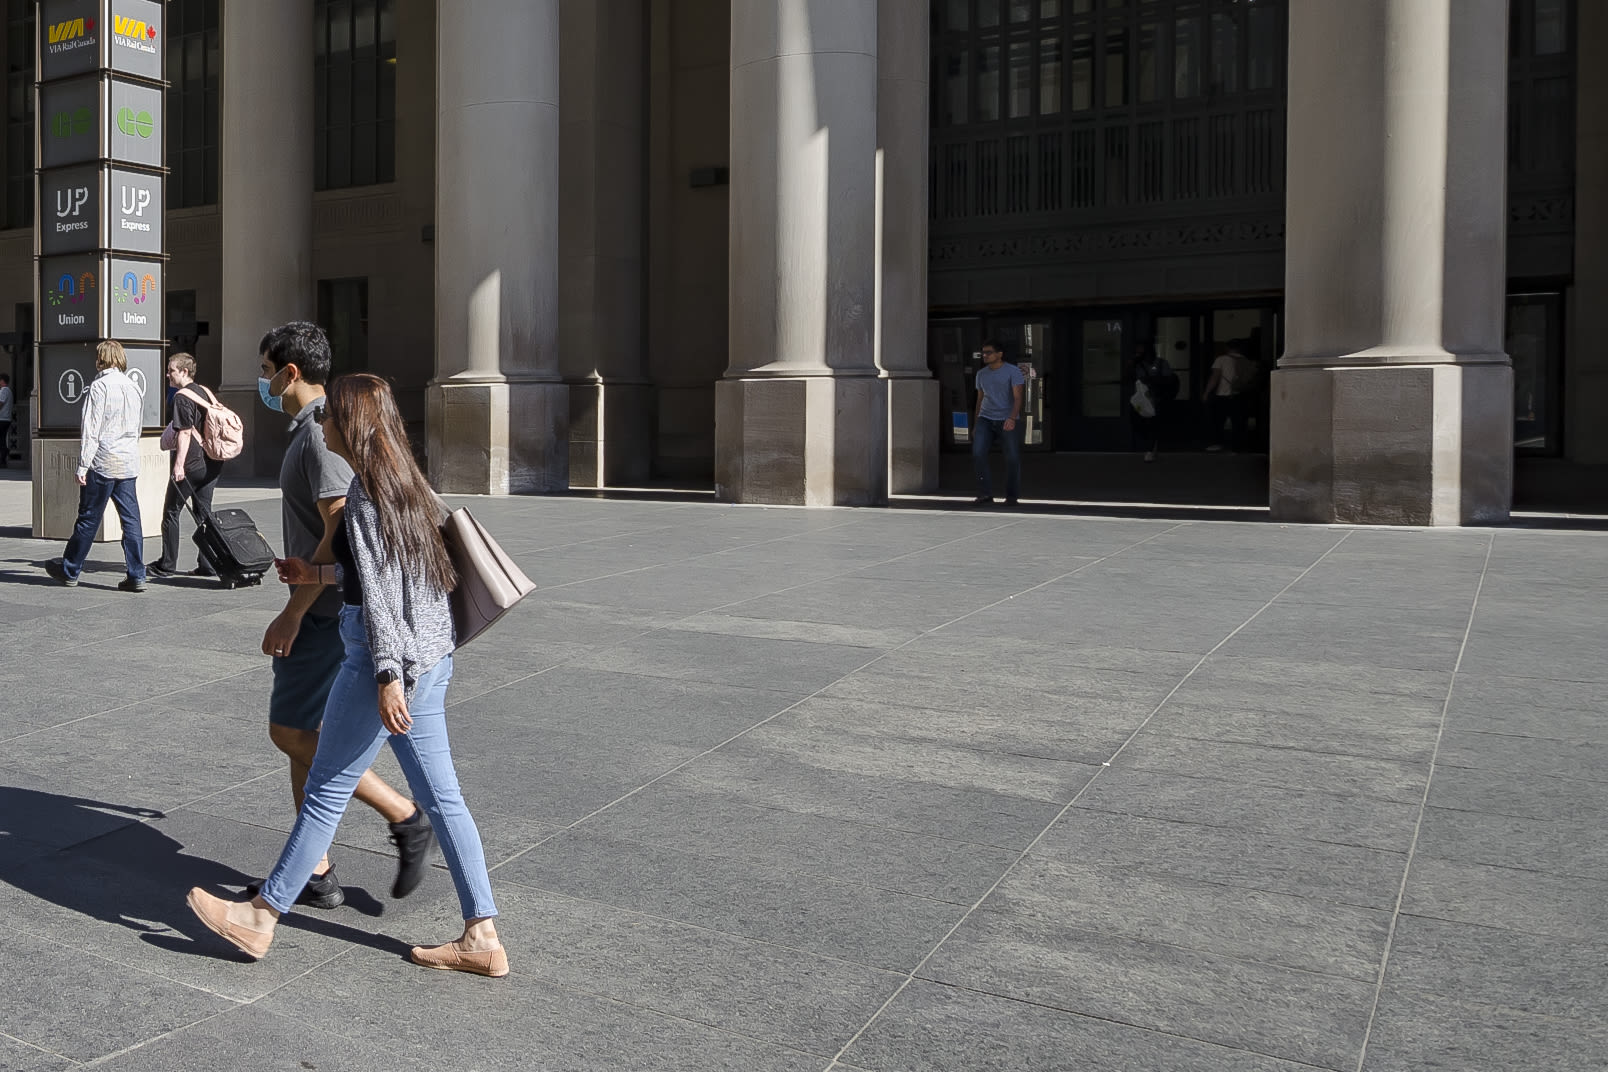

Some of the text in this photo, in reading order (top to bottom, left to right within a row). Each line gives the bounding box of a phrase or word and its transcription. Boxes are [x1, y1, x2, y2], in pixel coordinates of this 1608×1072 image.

[49, 18, 84, 44] VIA
[114, 15, 146, 41] VIA
[49, 36, 96, 54] VIA Rail Canada
[114, 35, 156, 54] VIA Rail Canada
[116, 107, 154, 139] GO
[56, 186, 89, 218] UP
[121, 185, 151, 217] UP
[56, 220, 89, 233] Express
[121, 218, 151, 232] Express
[58, 313, 85, 326] Union
[123, 311, 147, 325] Union
[1106, 321, 1122, 333] 1A
